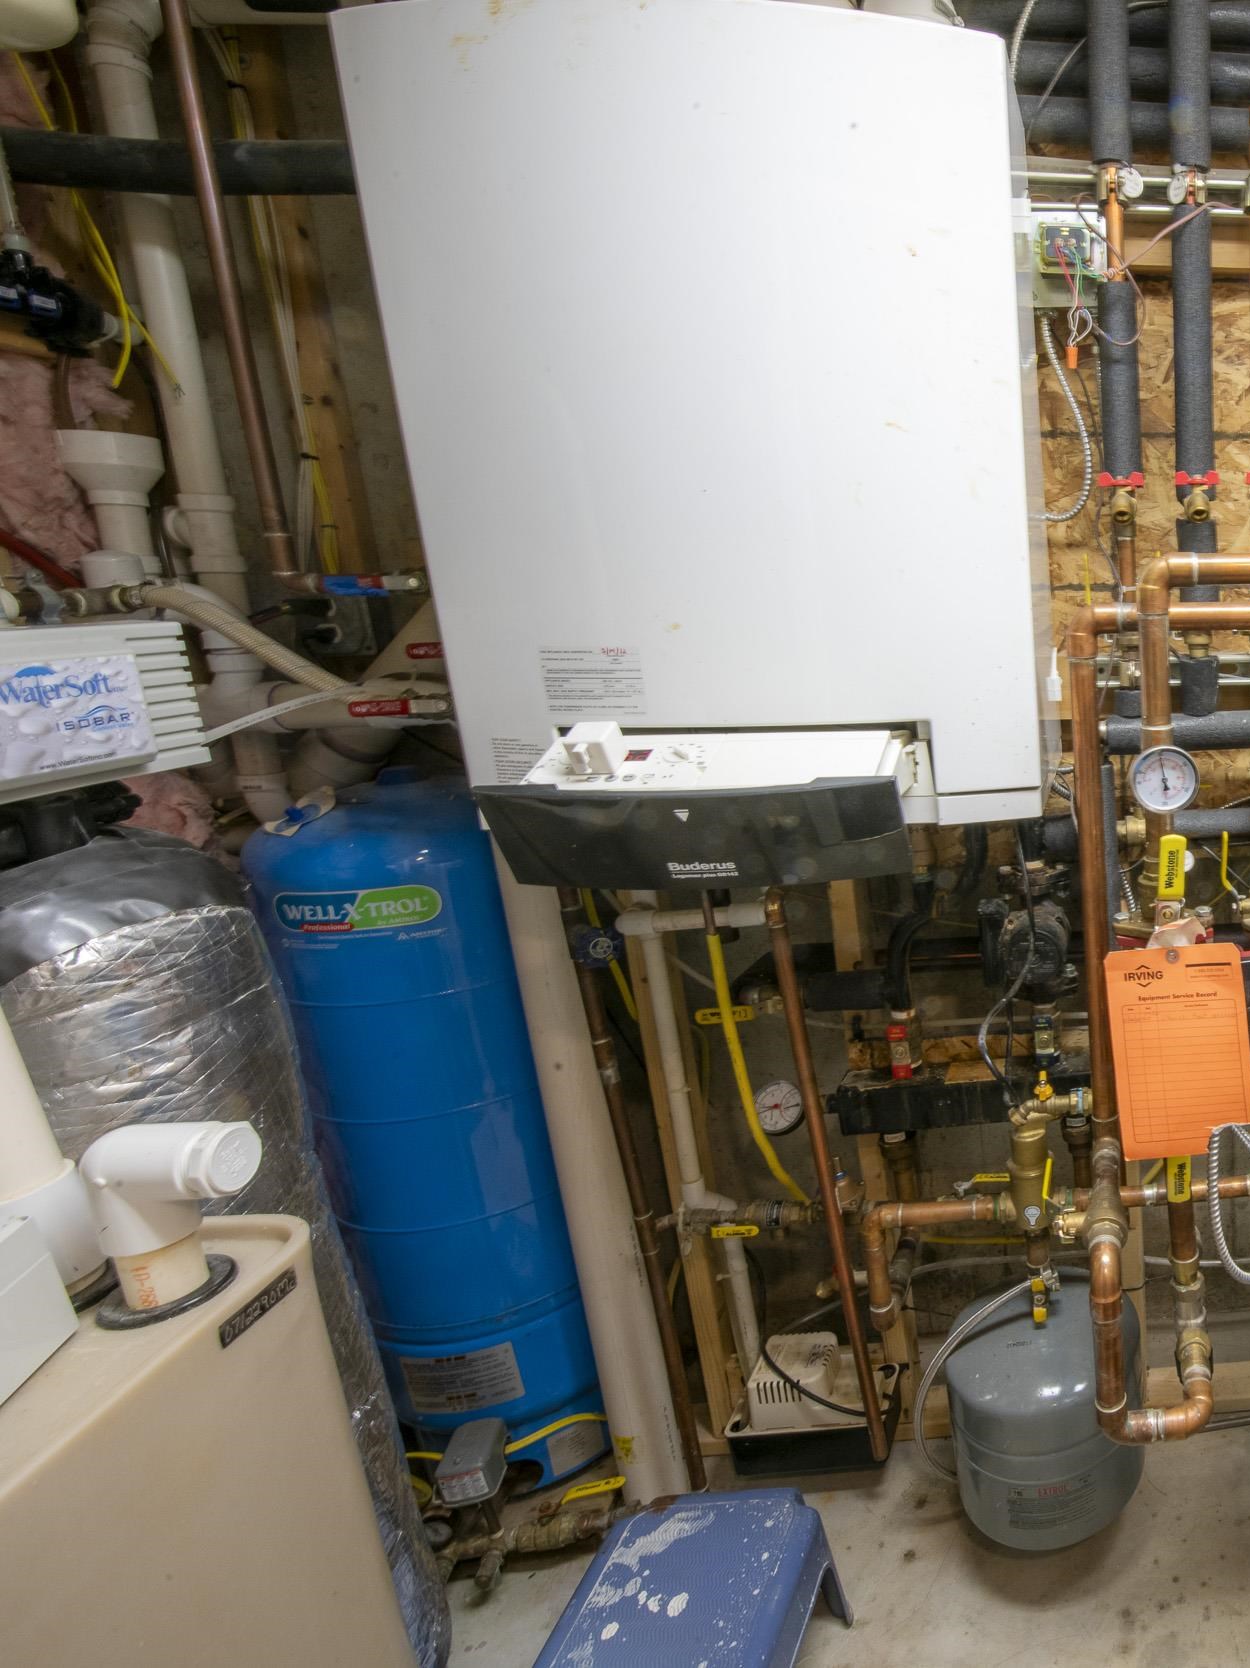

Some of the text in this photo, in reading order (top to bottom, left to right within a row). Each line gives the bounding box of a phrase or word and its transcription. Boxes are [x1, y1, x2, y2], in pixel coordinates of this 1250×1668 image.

[56, 712, 131, 731] ISOBAR
[667, 862, 736, 871] Buderus
[1165, 850, 1176, 889] Webstone
[277, 897, 429, 921] WELL-X-TROL
[303, 922, 351, 932] Professional
[1124, 971, 1164, 982] IRVING
[1138, 994, 1171, 1002] Equipment
